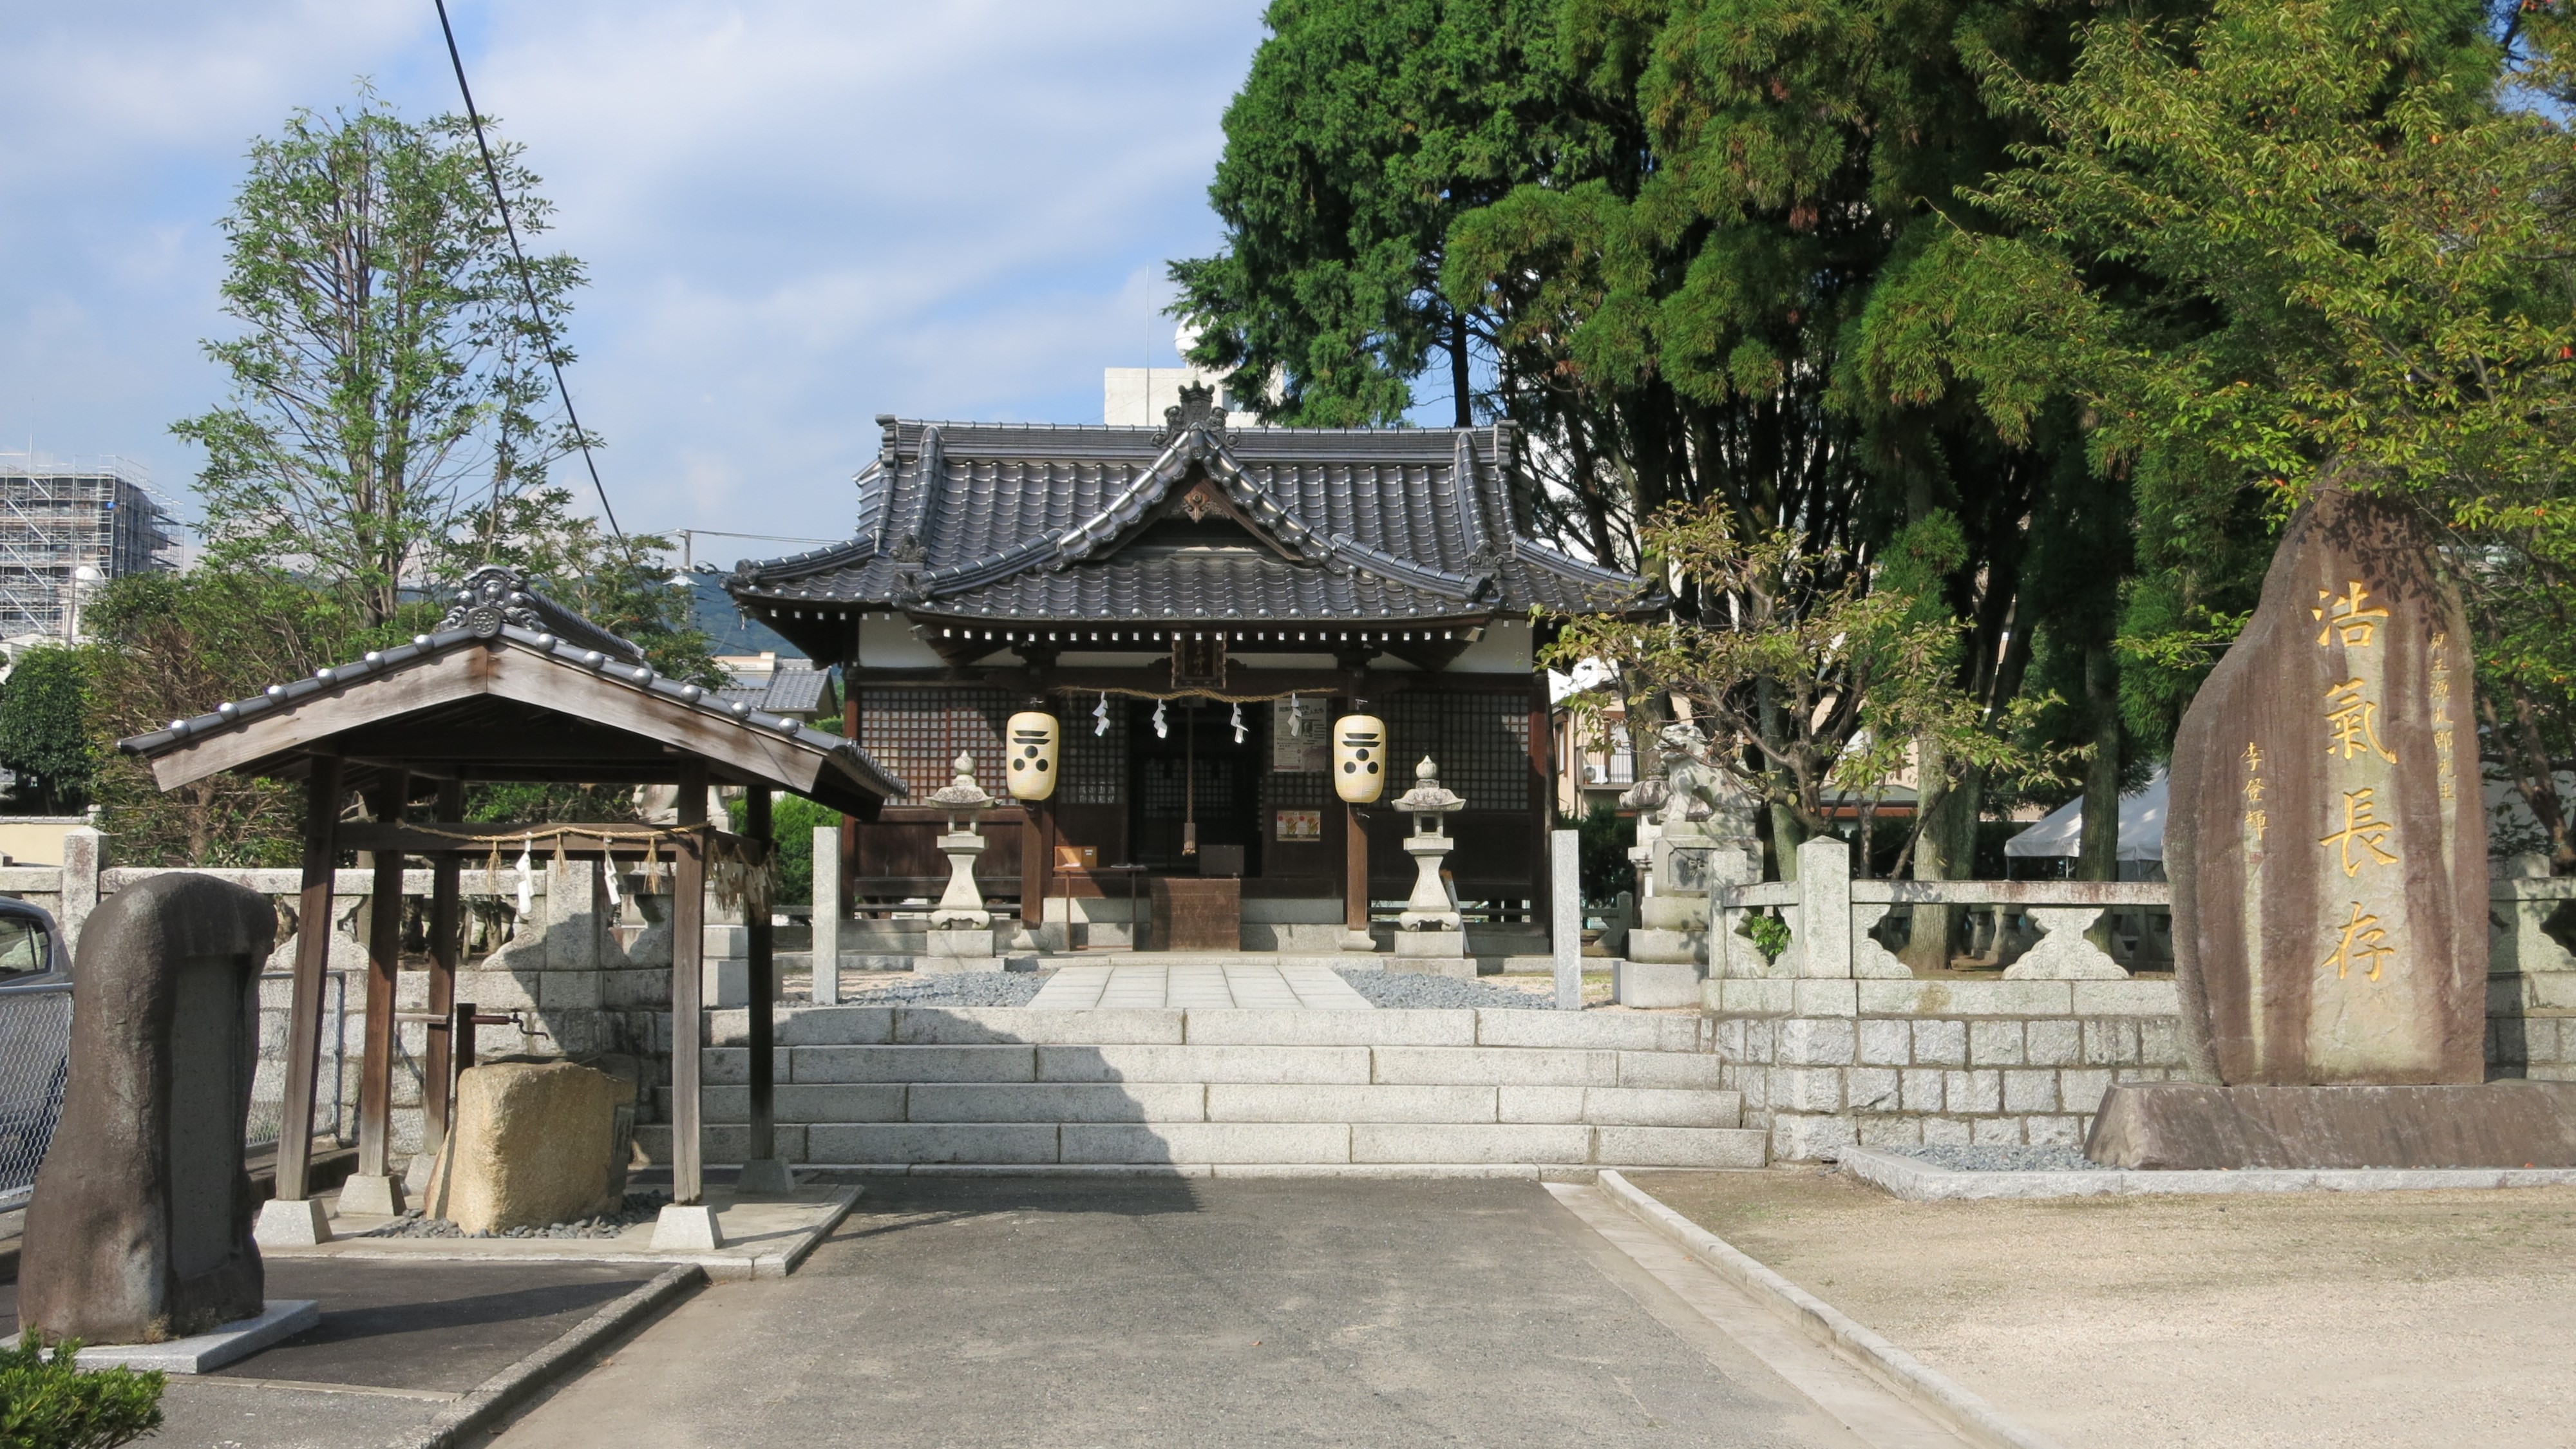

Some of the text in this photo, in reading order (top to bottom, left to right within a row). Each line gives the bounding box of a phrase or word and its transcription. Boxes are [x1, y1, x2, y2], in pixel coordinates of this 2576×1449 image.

[2240, 741, 2269, 841] 李登輝
[2311, 581, 2398, 982] 浩氣長存
